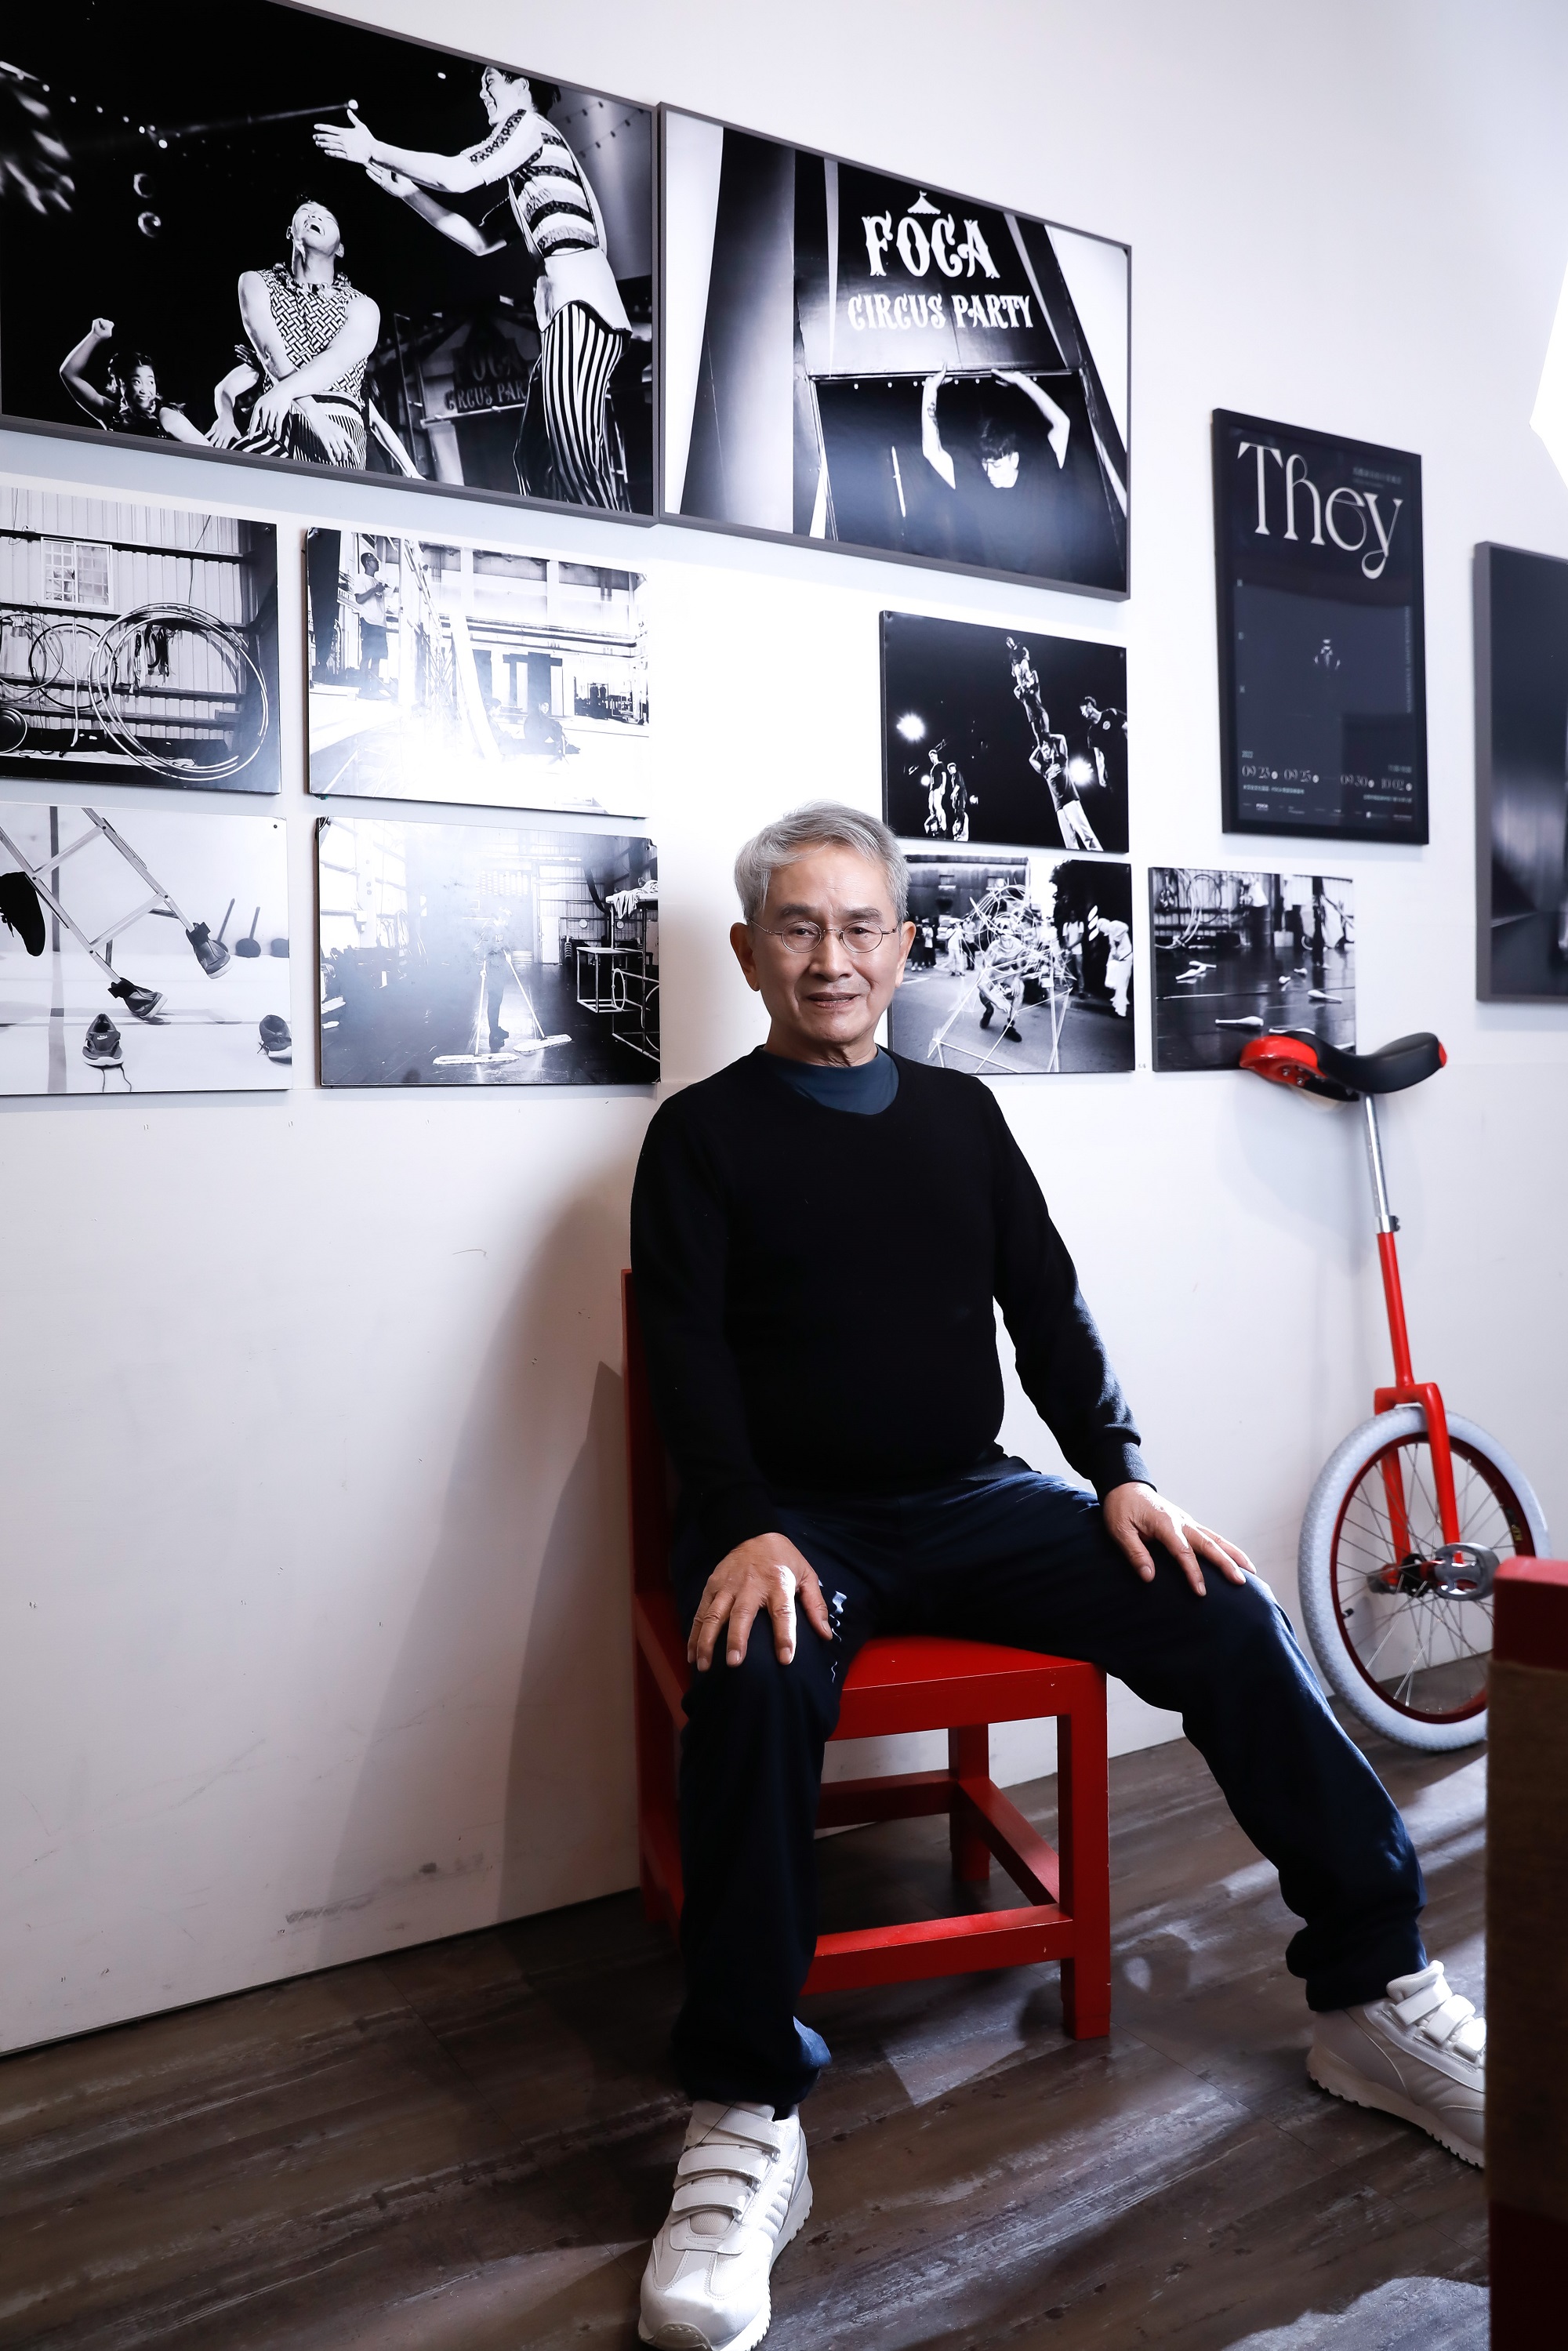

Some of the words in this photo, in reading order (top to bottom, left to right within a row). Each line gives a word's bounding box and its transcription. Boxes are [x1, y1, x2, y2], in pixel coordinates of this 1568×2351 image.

[862, 210, 1000, 278] FOCA
[847, 293, 946, 331] CIRCUS
[951, 293, 1034, 329] PARTY
[1237, 441, 1403, 579] They
